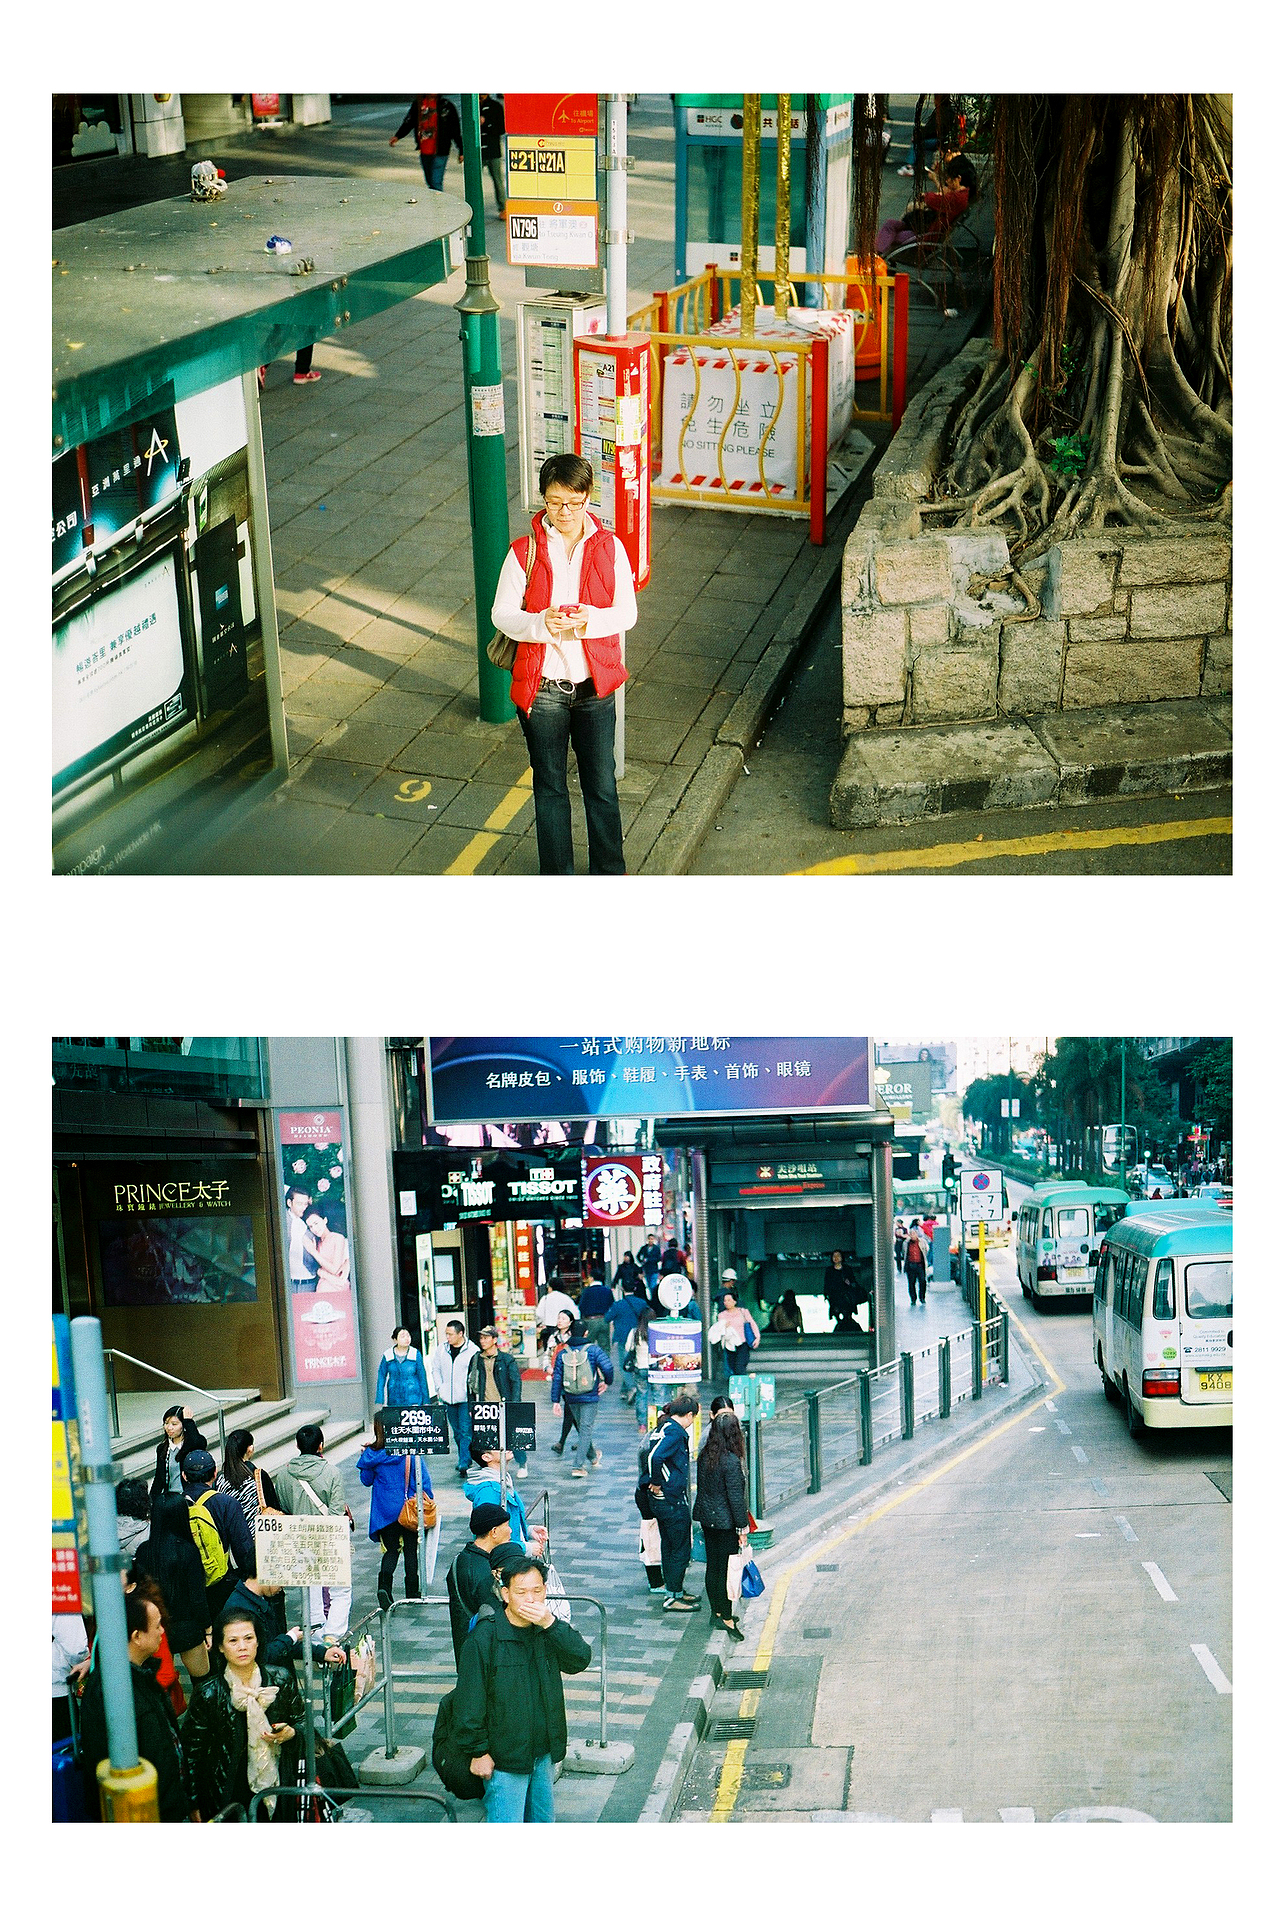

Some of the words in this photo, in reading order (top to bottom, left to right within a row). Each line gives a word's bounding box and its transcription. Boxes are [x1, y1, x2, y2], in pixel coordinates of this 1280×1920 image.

[705, 114, 723, 123] HGC
[512, 219, 538, 238] N796
[602, 363, 615, 372] A21
[681, 392, 777, 419] 請勿坐立
[91, 455, 142, 498] 亞洲萬里通
[290, 1126, 332, 1135] PEONIA
[114, 1182, 191, 1204] PRINCE
[192, 1180, 230, 1200] 太子
[507, 1180, 578, 1196] TISSOT
[206, 1200, 231, 1208] WATCH
[1200, 1381, 1232, 1391] 9408
[400, 1409, 432, 1426] 269B
[474, 1405, 500, 1420] 260
[257, 1518, 283, 1532] 268B
